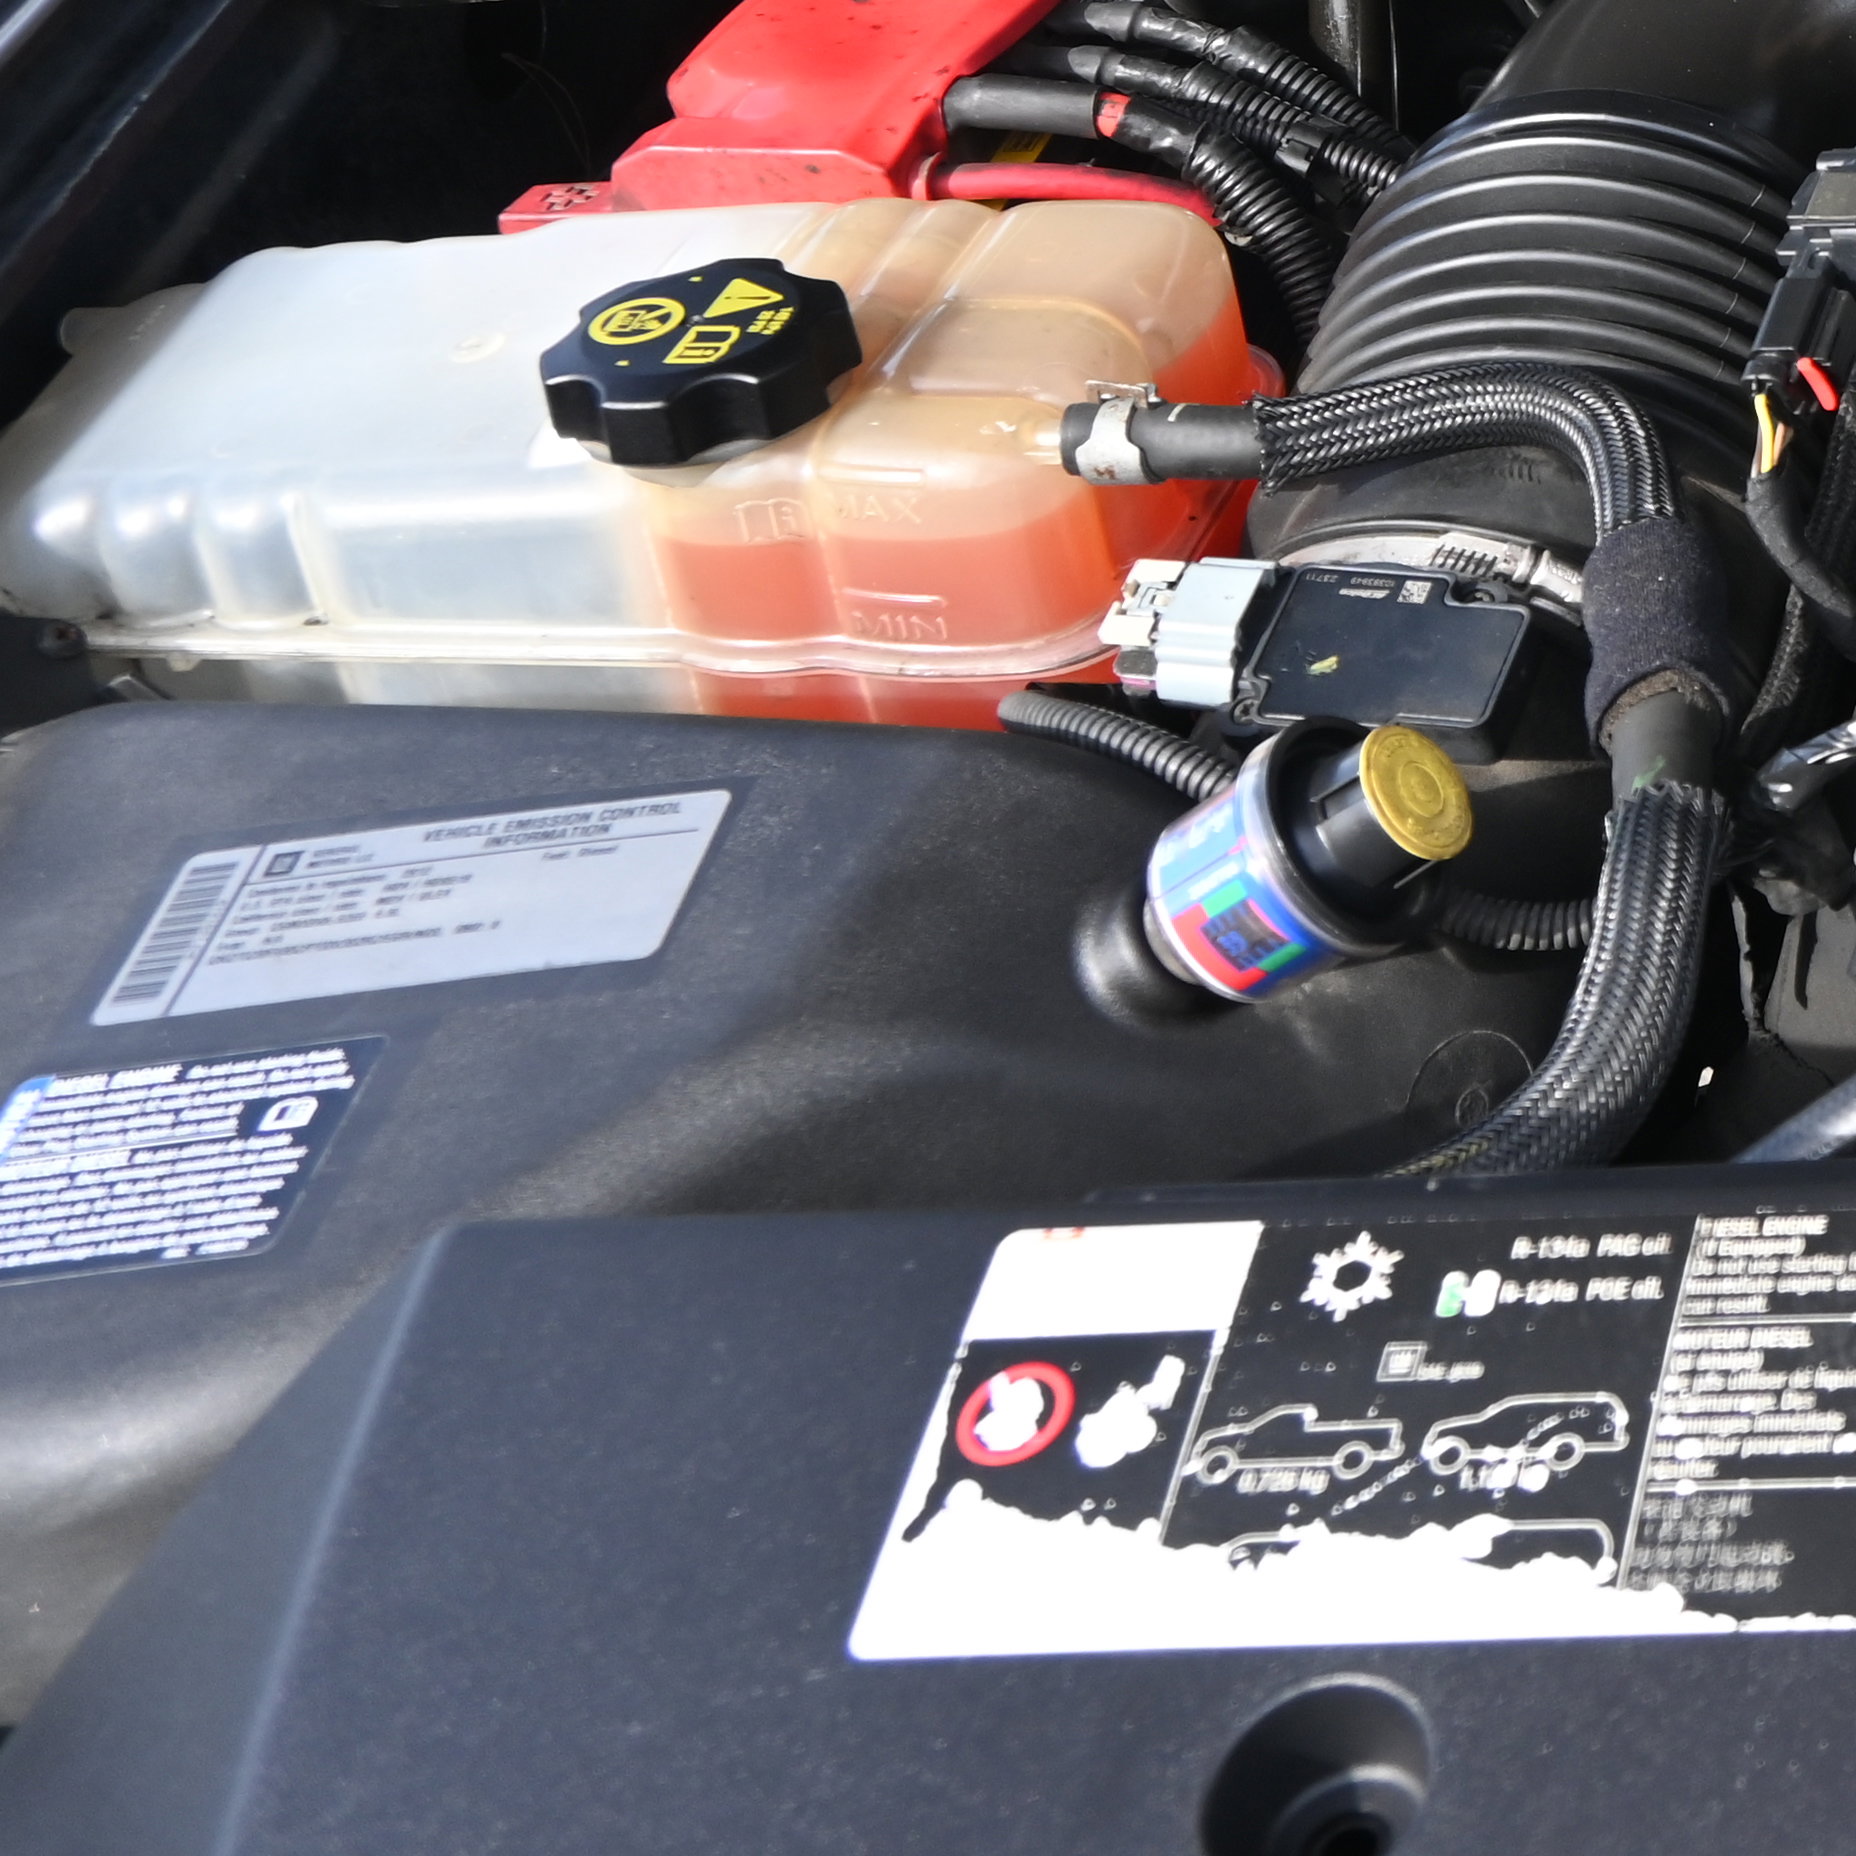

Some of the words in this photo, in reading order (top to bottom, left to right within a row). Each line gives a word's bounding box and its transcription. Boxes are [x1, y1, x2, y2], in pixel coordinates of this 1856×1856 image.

[838, 495, 923, 524] MAX
[851, 611, 948, 640] MIN
[424, 822, 498, 843] VEHICLE
[502, 810, 594, 834] EMISSION
[599, 801, 682, 822] CONTROL
[482, 823, 613, 848] INFORMATION
[1761, 1214, 1830, 1236] ENGINE
[1511, 1234, 1591, 1259] R-134a
[1597, 1232, 1643, 1257] PAG
[1499, 1278, 1580, 1304] R-134a
[1585, 1276, 1633, 1301] POE
[1750, 1325, 1815, 1349] DIESEL
